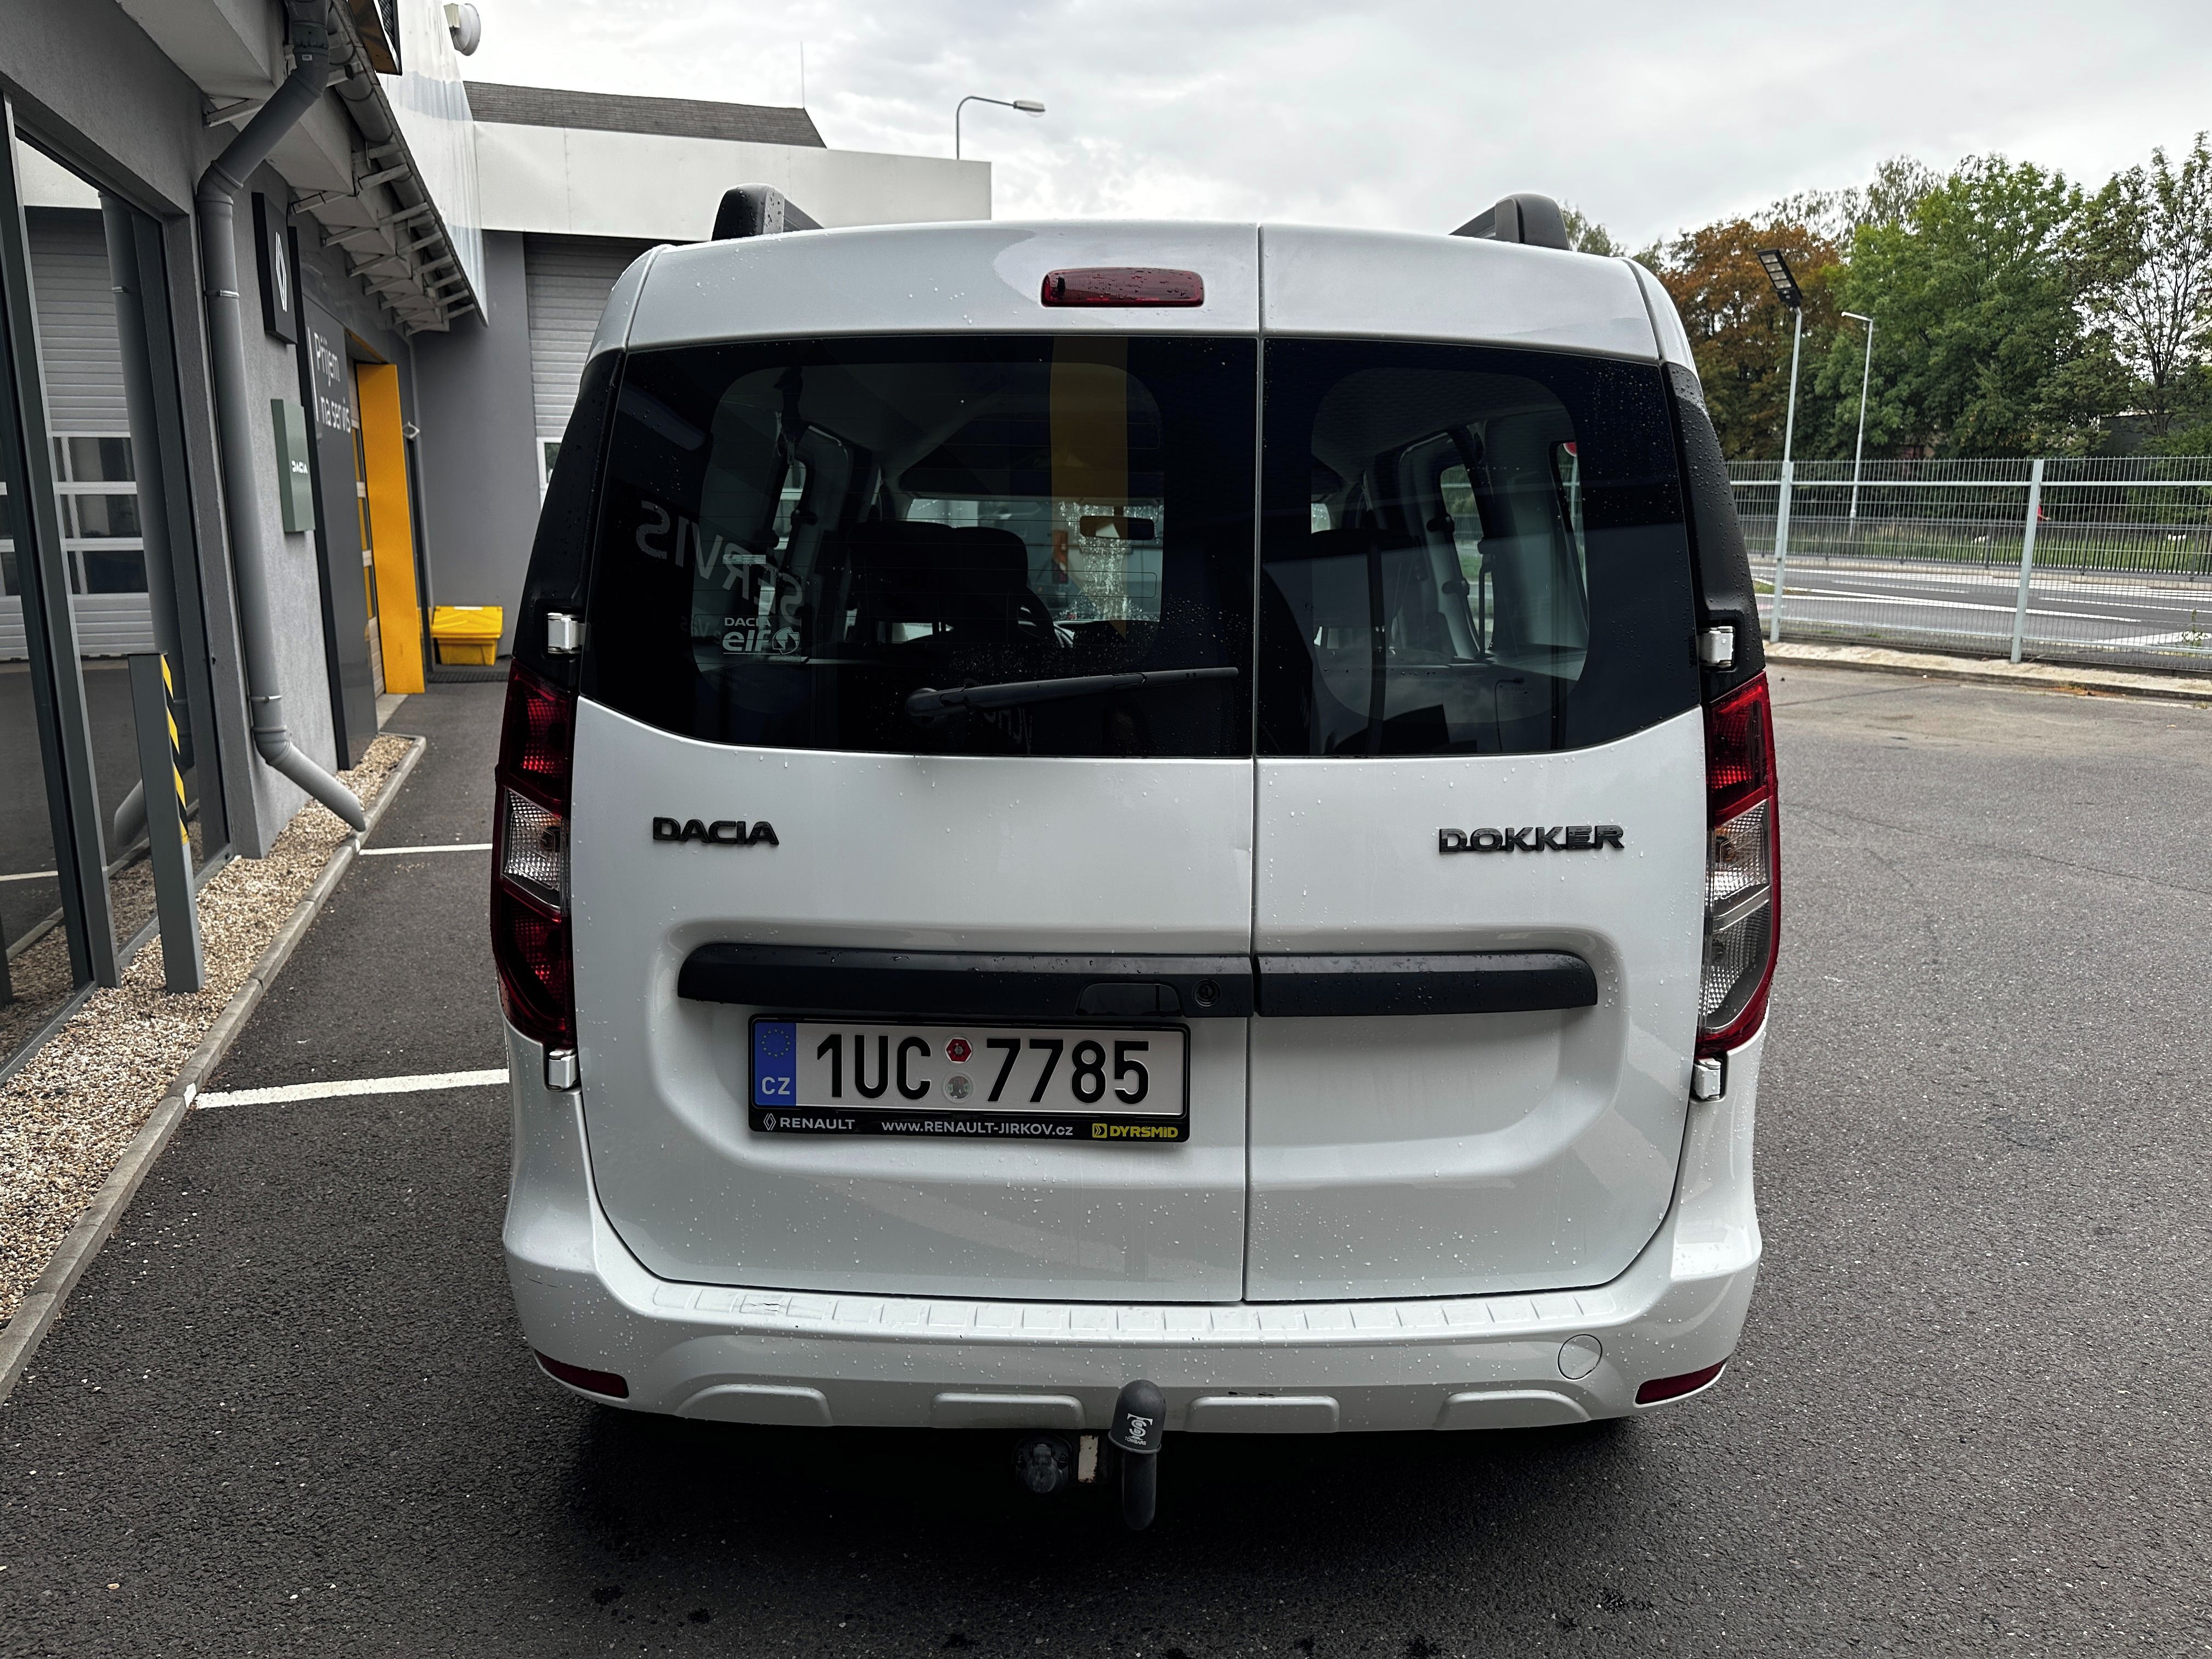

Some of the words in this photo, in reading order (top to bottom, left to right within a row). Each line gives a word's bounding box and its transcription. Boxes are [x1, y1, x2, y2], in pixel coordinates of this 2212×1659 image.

[320, 396, 332, 427] na
[331, 397, 351, 434] servis
[724, 617, 771, 627] DACIA
[723, 629, 771, 652] elf
[653, 816, 780, 845] DACIA
[1439, 825, 1625, 853] DOKKER
[817, 1034, 931, 1099] 1UC
[986, 1037, 1149, 1104] 7785
[761, 1076, 791, 1095] CZ
[780, 1117, 855, 1130] RENAULT
[881, 1121, 1074, 1136] www.RENAULT-JIRKOV.cz
[1125, 1436, 1147, 1446] TOWBARS
